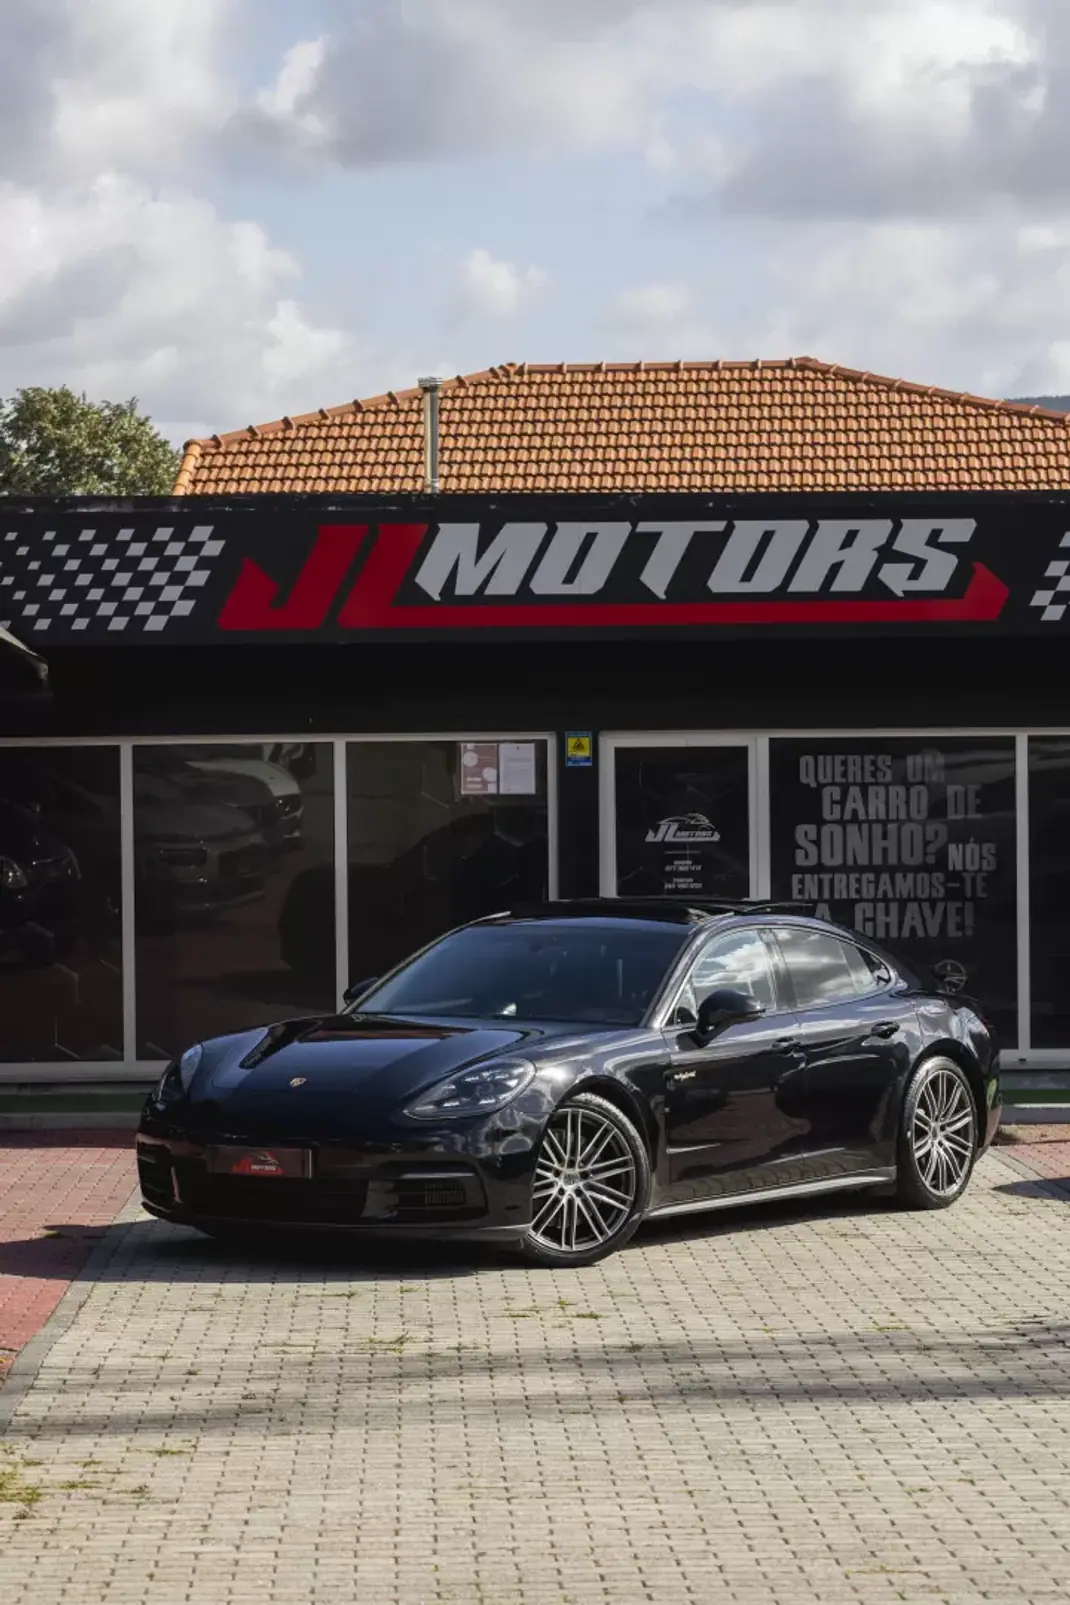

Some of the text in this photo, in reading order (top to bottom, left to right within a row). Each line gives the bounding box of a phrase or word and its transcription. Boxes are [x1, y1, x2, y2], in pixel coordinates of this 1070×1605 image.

[414, 517, 978, 601] MOTORS
[799, 754, 946, 788] QUERES UM
[821, 784, 983, 821] CARRO DE
[794, 822, 998, 871] SONHO? NÓS
[791, 871, 988, 901] ENTREGAMOS-TE
[853, 902, 975, 938] CHAVE!
